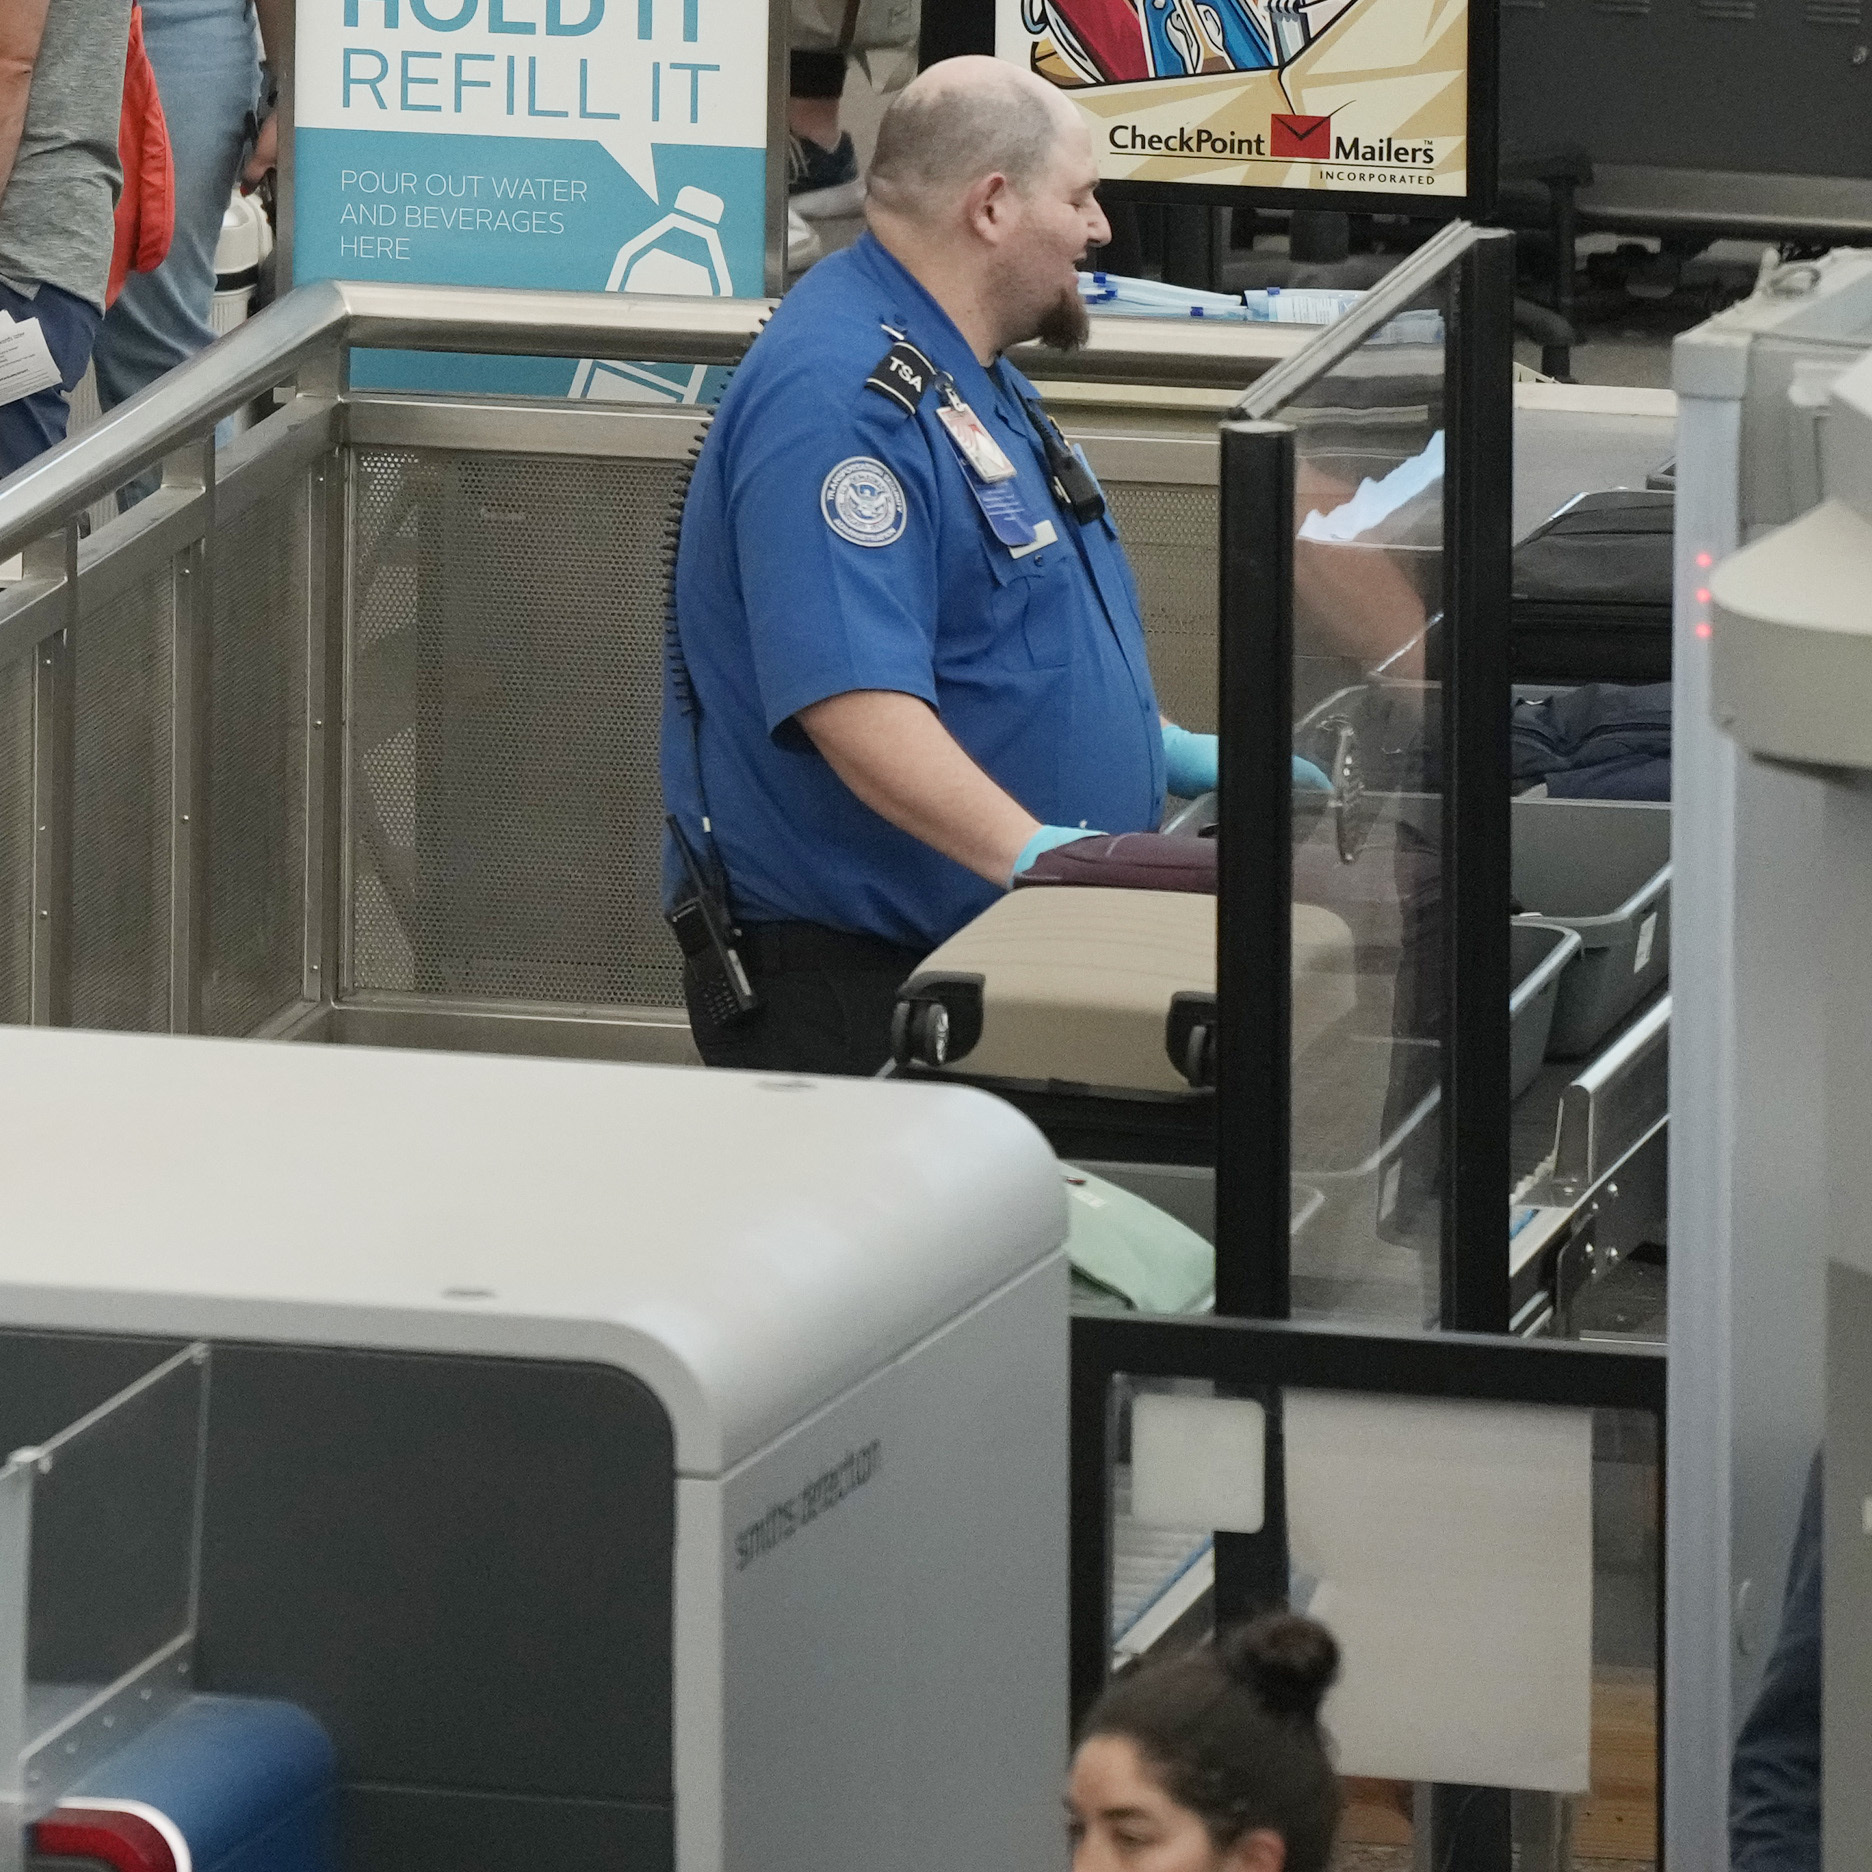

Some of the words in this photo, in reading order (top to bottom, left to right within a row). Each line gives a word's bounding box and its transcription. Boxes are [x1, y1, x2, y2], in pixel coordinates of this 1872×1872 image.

[342, 47, 621, 121] REFILL
[651, 61, 720, 124] IT
[1108, 124, 1266, 156] CheckPoint
[1334, 135, 1434, 164] Mailers
[340, 169, 418, 195] POUR
[424, 173, 485, 198] OUT
[491, 176, 588, 203] WATER
[1319, 170, 1435, 186] INCORPORATED
[339, 203, 398, 227] AND
[404, 205, 565, 235] BEVERAGES
[340, 235, 411, 260] HERE
[888, 356, 923, 393] TSA
